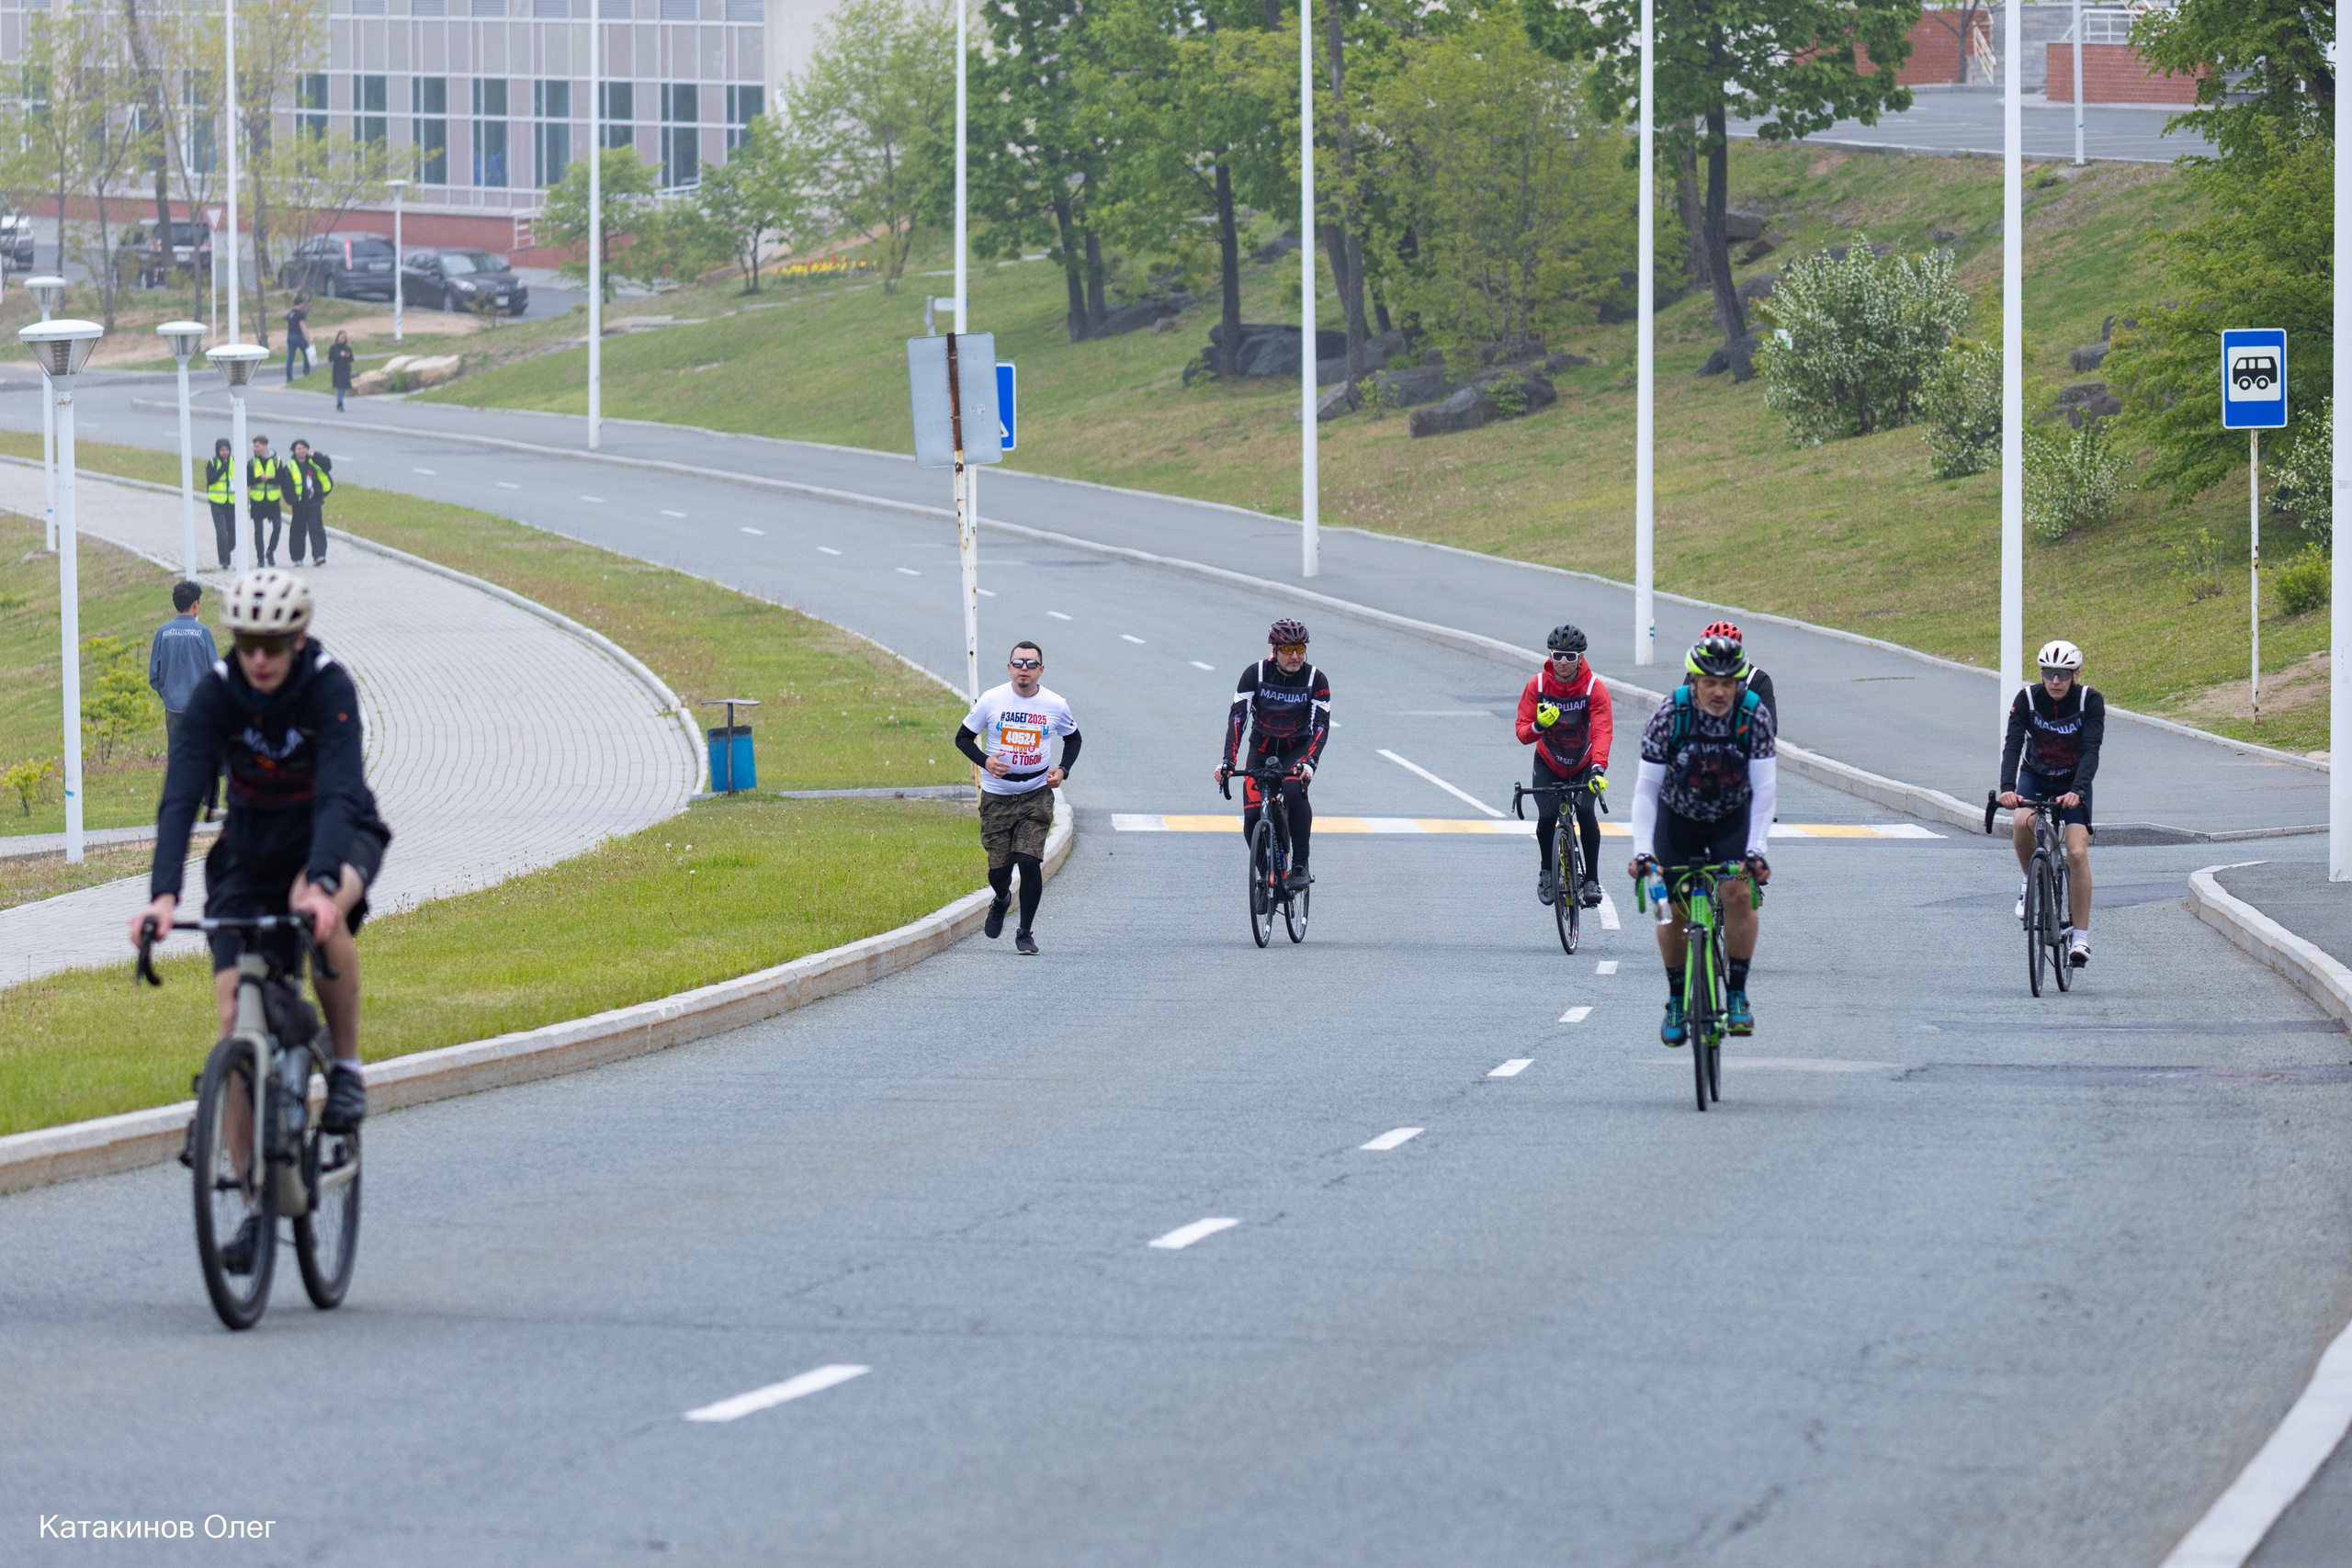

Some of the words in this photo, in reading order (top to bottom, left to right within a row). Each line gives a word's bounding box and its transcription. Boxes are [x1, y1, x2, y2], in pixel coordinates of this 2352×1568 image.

[1260, 688, 1307, 703] МАРШАЛ
[1001, 711, 1046, 725] #ЗАБЕГ2025
[1005, 730, 1035, 745] 40524
[1012, 754, 1018, 765] С
[1020, 752, 1042, 766] ТОБОЙ
